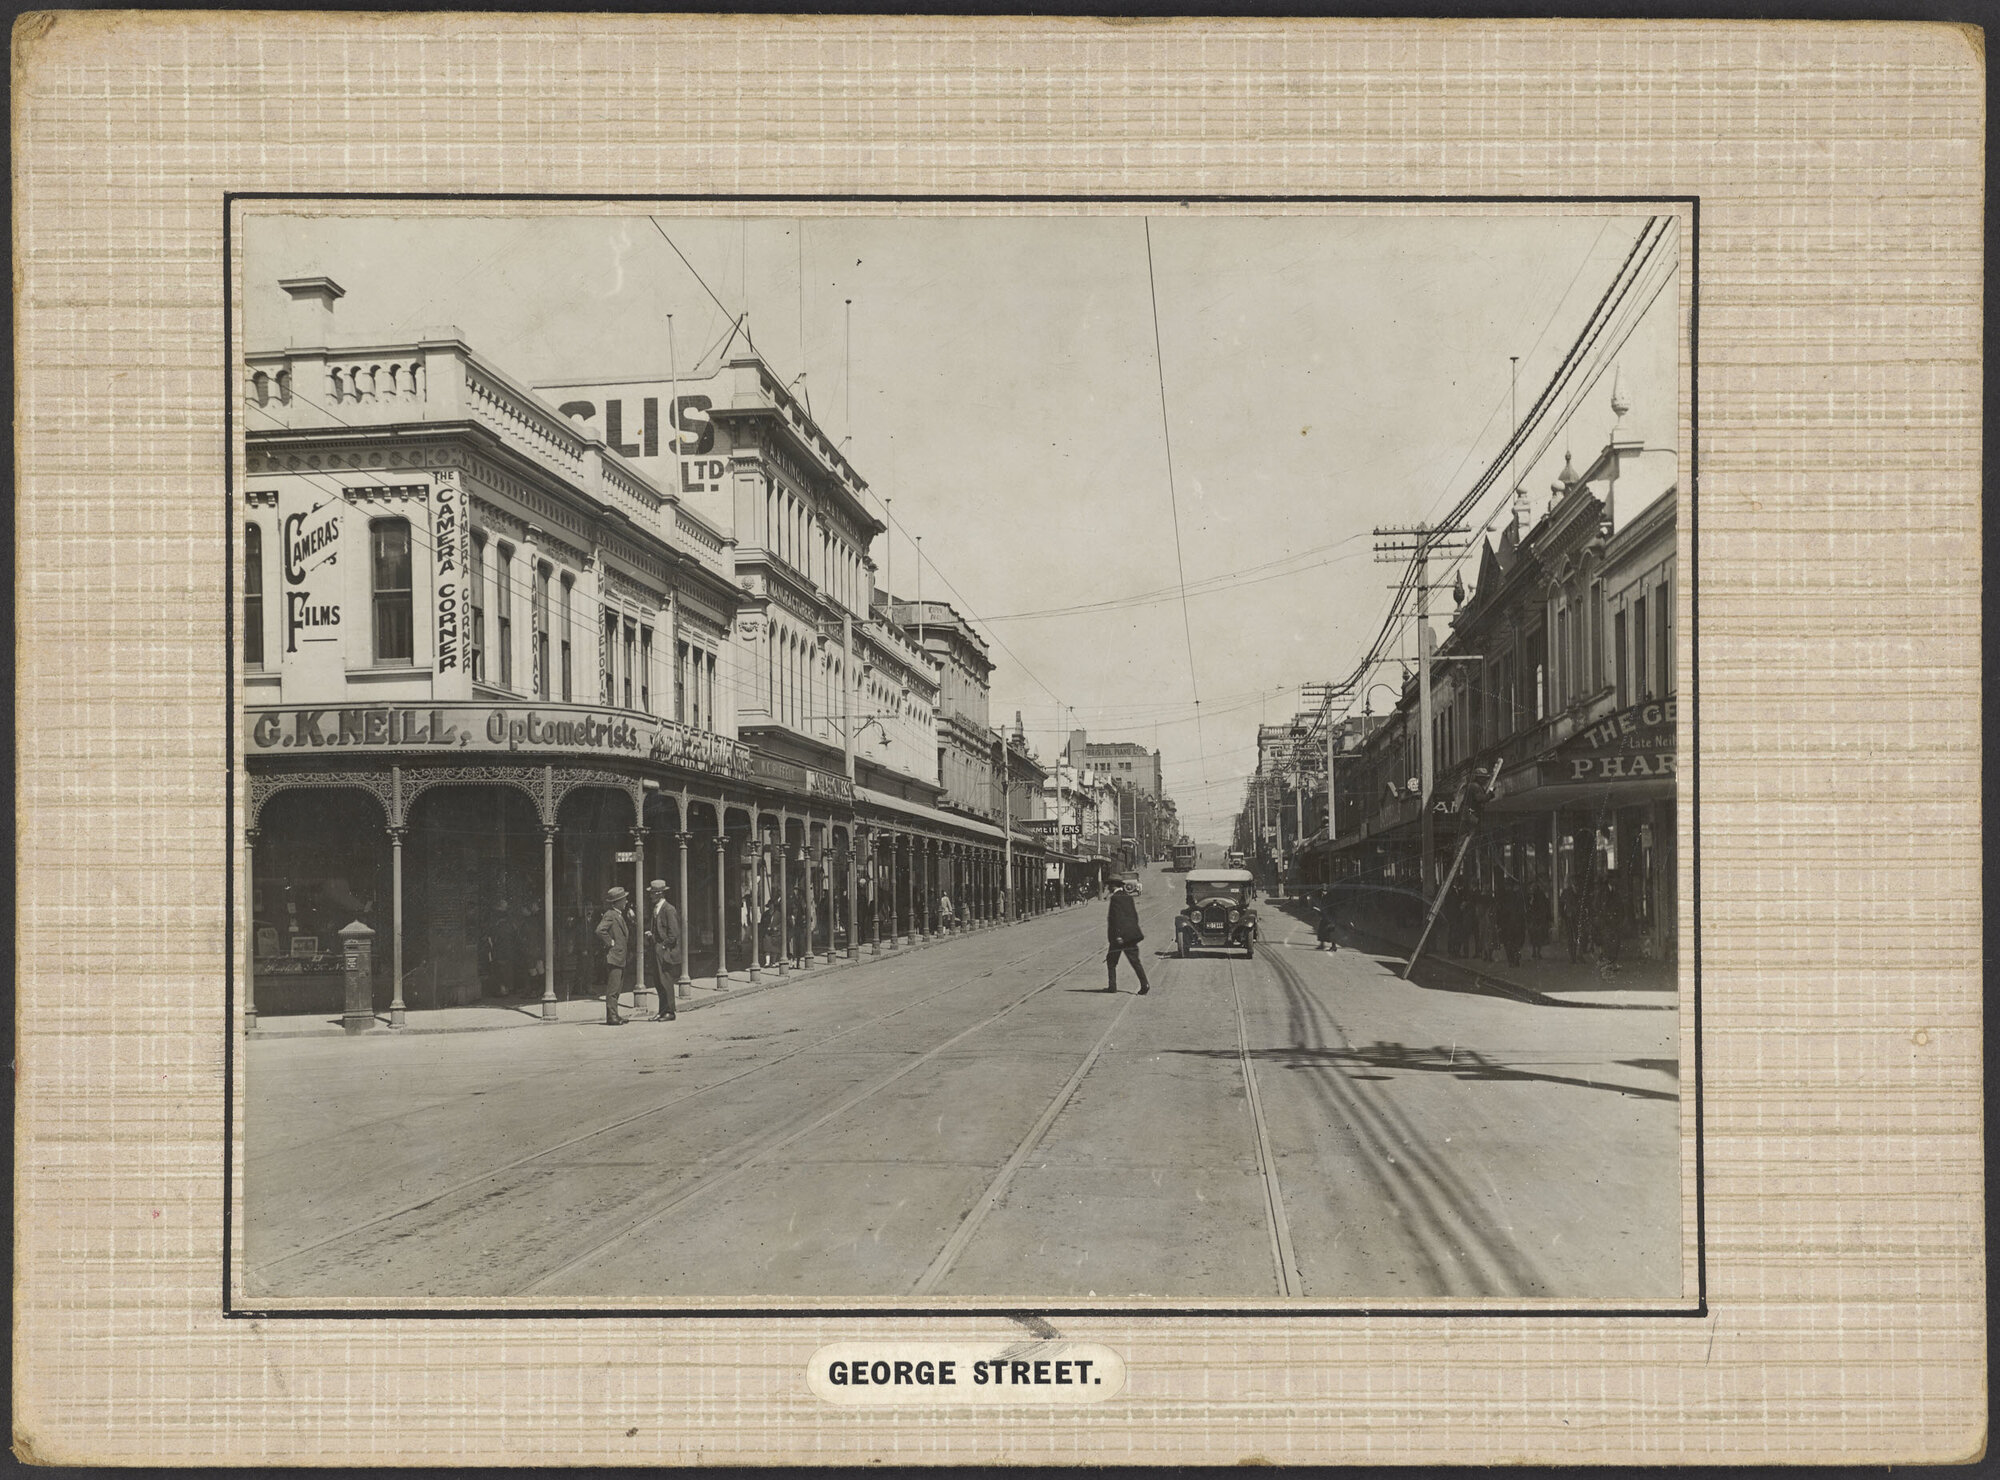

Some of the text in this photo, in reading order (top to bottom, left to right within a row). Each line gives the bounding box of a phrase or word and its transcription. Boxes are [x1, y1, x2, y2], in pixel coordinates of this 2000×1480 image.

[284, 512, 340, 586] CAMERAS
[460, 493, 469, 580] CAMERA
[433, 471, 457, 675] THE CAMERA CORNER
[286, 591, 341, 653] FILMS
[462, 588, 471, 675] CORNER
[531, 553, 539, 695] CAMERAS
[1584, 712, 1636, 749] THE
[1630, 737, 1652, 749] Late
[1571, 754, 1677, 779] PHAR
[829, 1360, 1101, 1386] GEORGE STREET.
